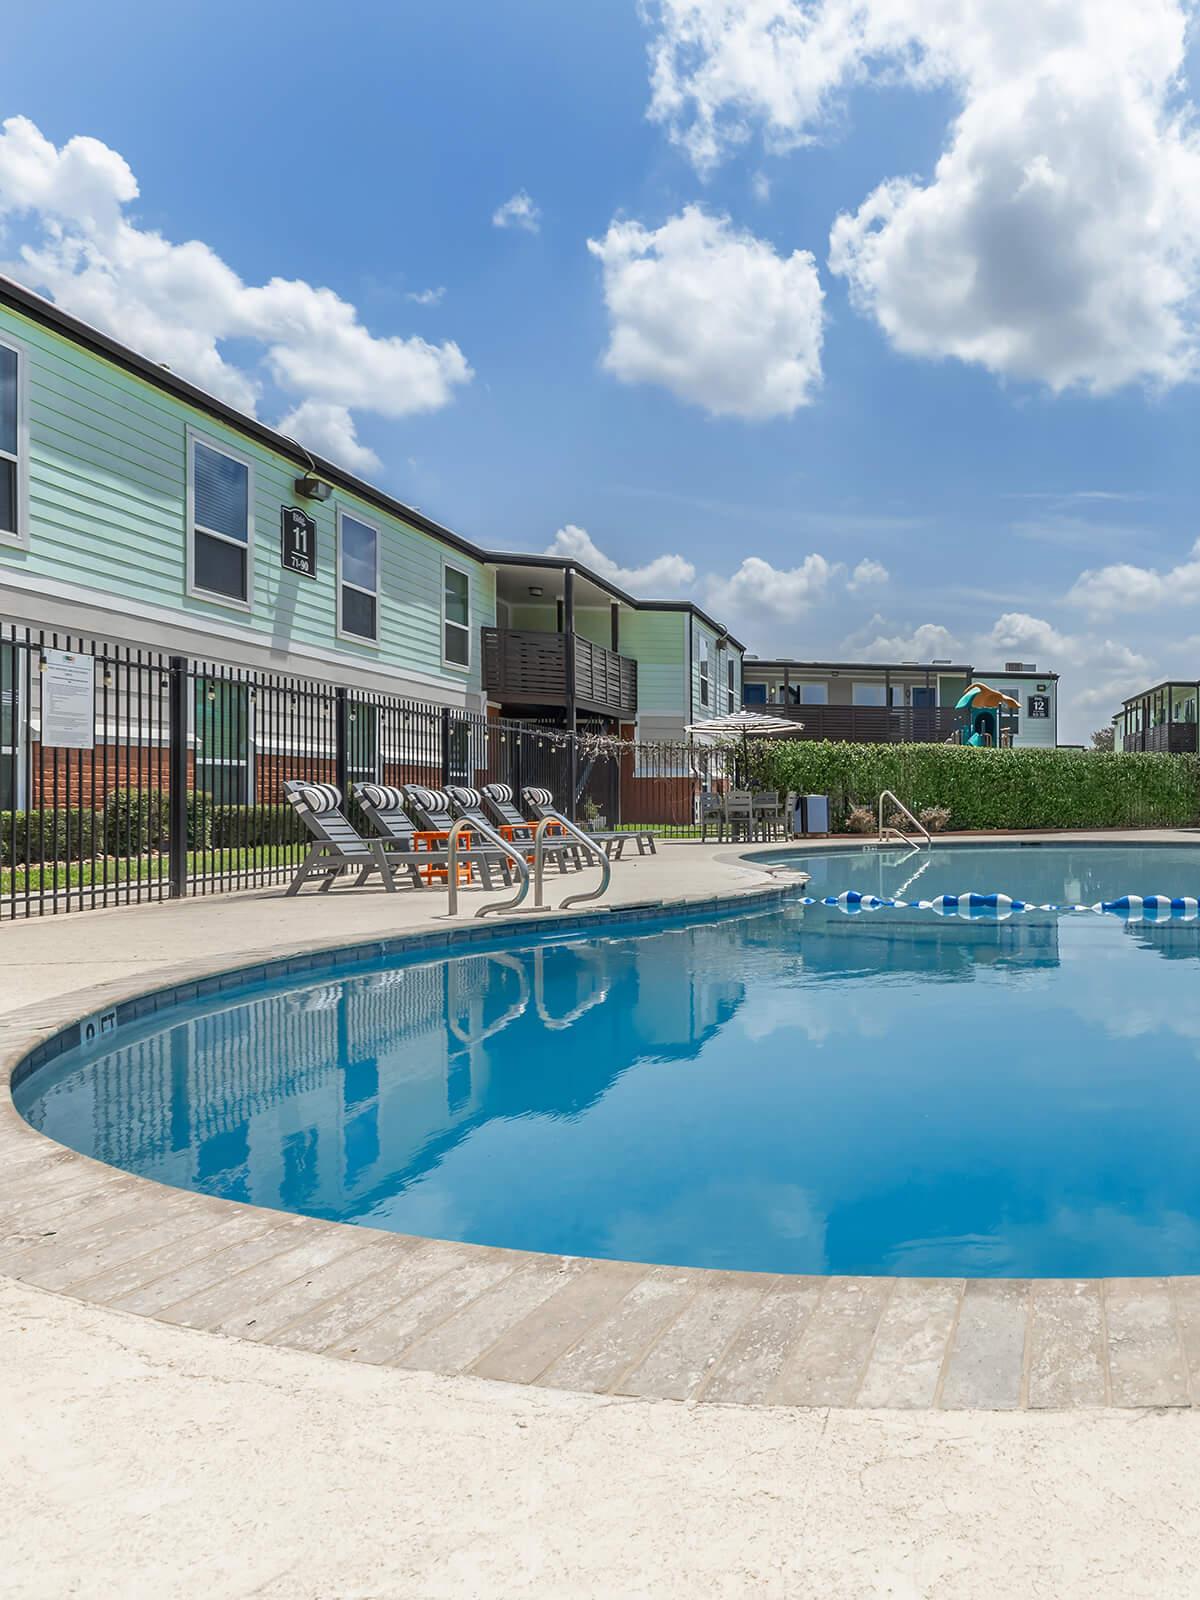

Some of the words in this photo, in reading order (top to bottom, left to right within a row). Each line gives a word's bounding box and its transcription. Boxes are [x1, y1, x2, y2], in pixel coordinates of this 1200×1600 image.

[293, 527, 307, 553] 11
[291, 556, 309, 572] 71-90
[1033, 701, 1045, 711] 12
